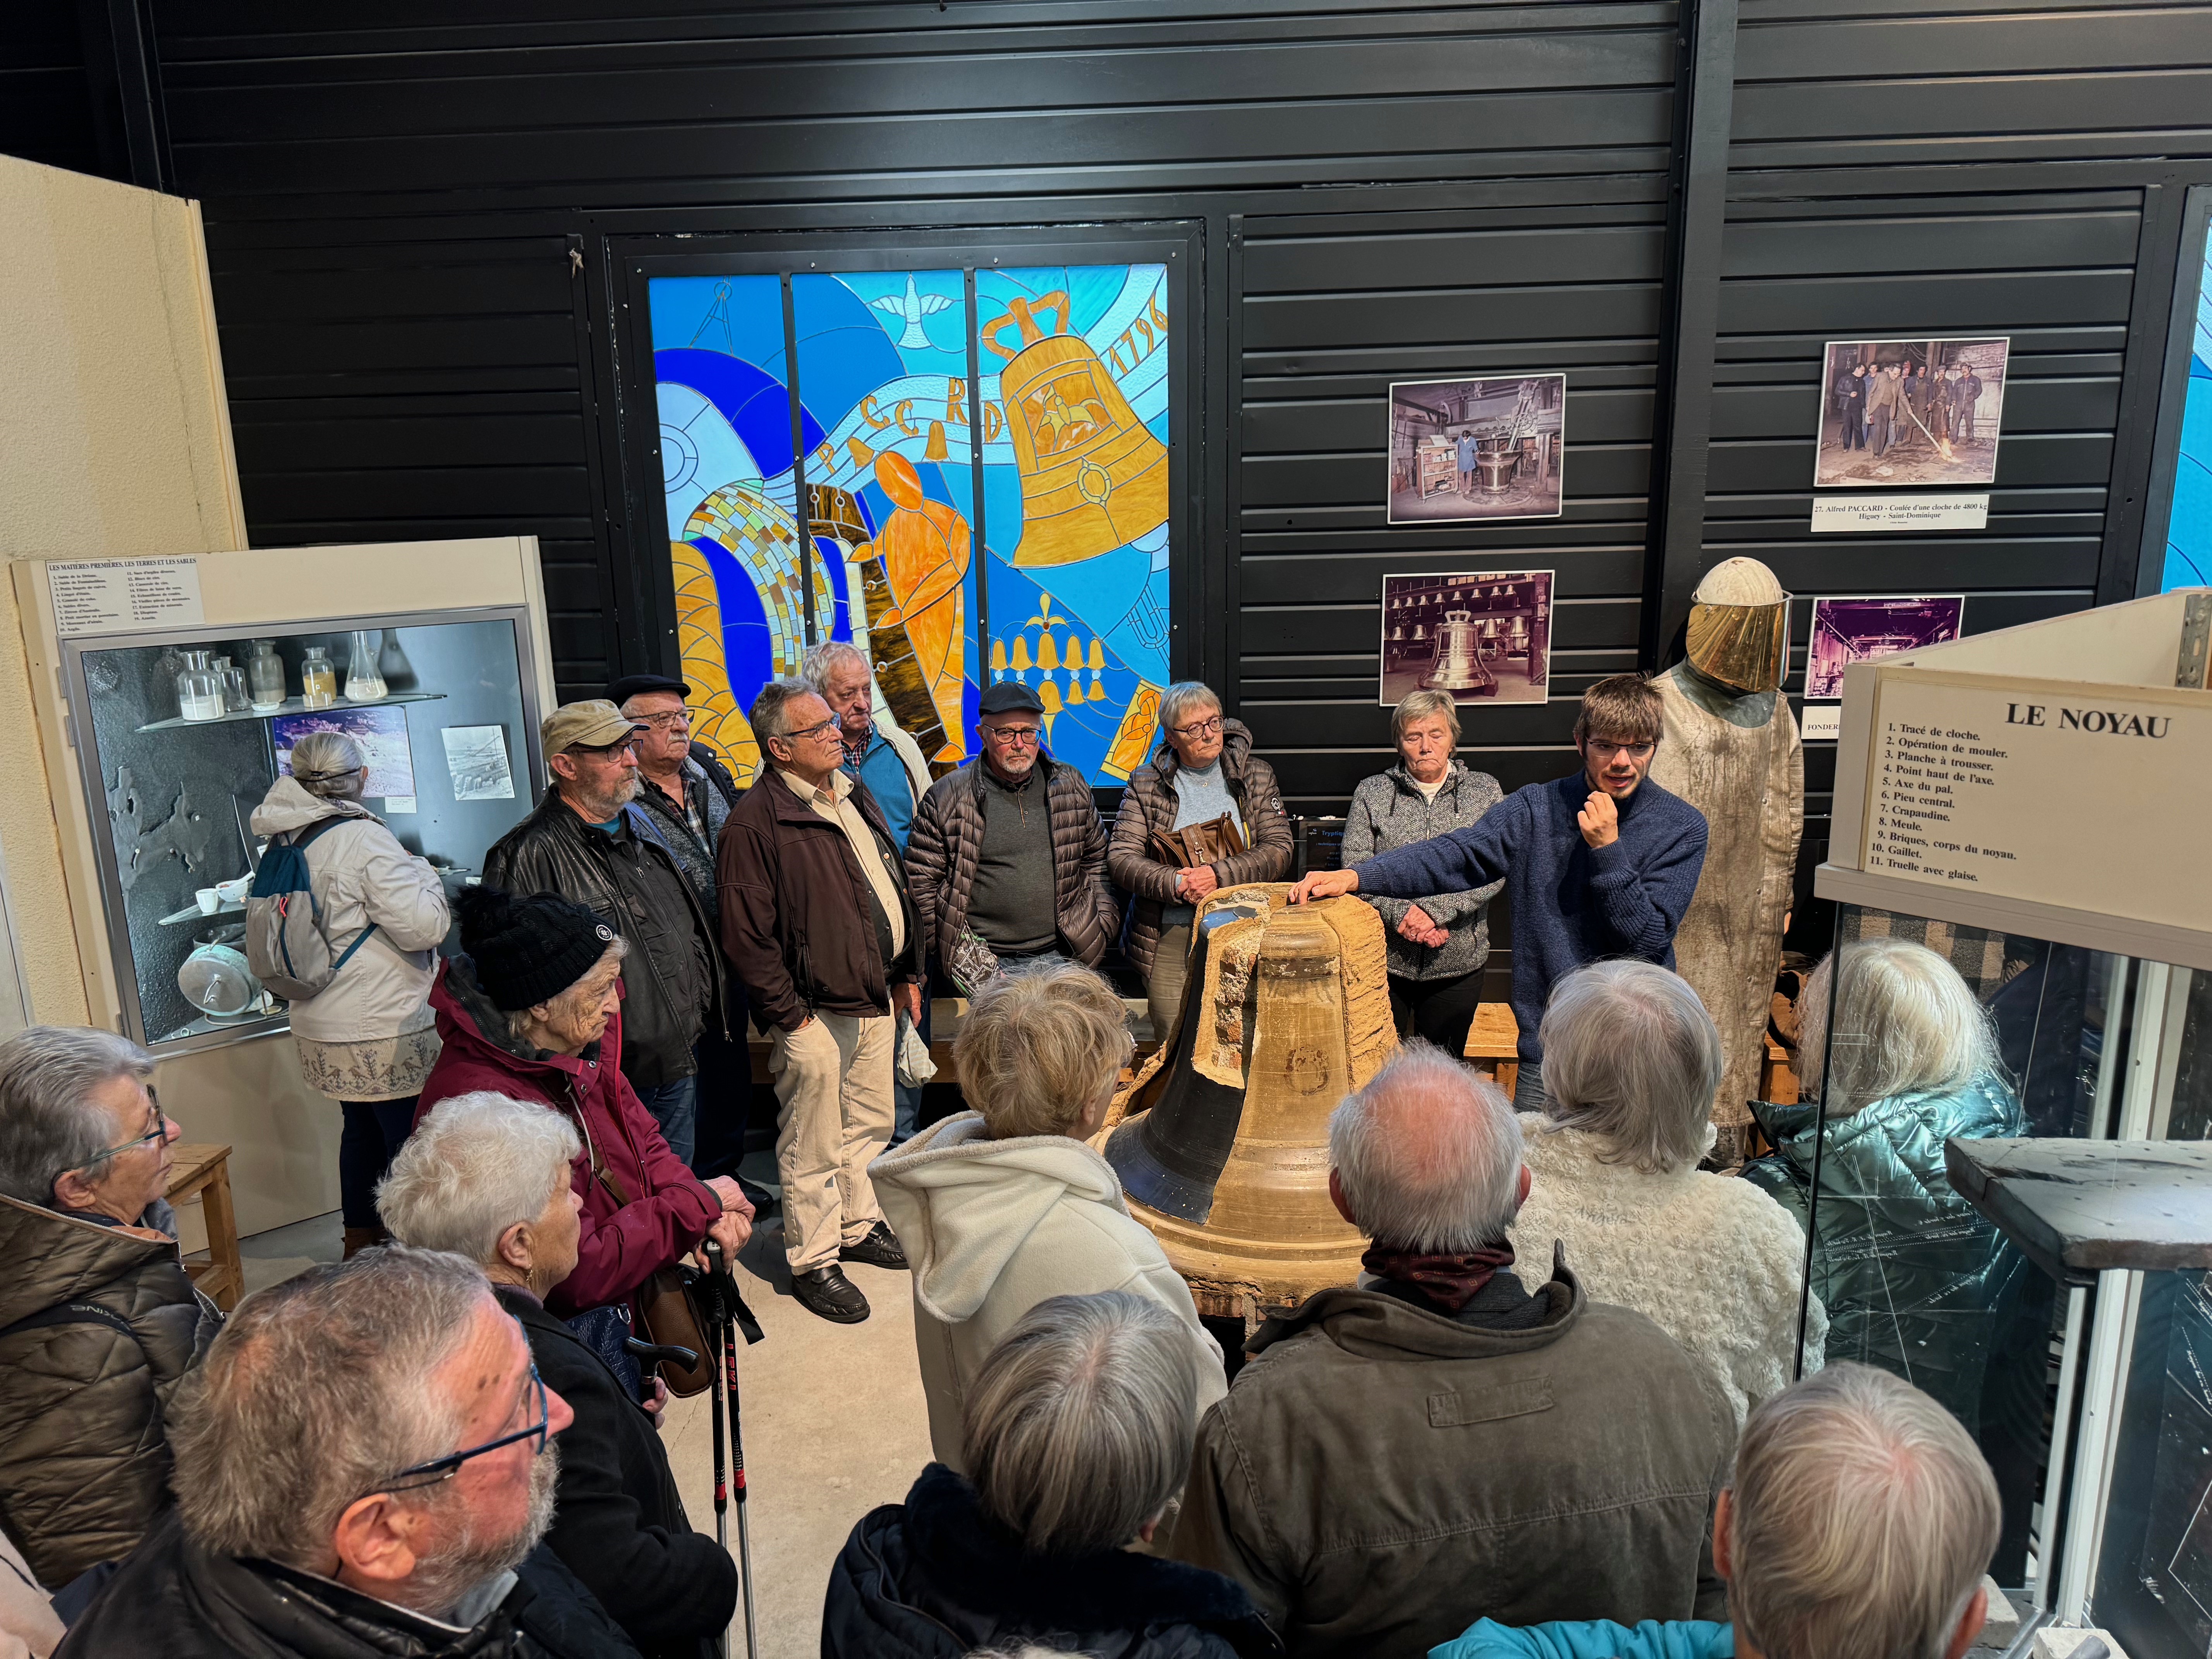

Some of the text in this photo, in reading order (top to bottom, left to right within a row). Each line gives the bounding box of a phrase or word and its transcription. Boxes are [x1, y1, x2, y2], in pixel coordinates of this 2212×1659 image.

[2005, 703, 2172, 738] LE NOYAU
[1888, 723, 1980, 741] 1. Tracé de cloche.
[1886, 736, 2008, 758] 2. Opération de mouler.
[1884, 749, 1994, 771] 3. Planche à trousser.
[1884, 763, 1994, 785] 4. Point haut de l'axe.
[1882, 777, 1953, 794] 5. Axe du pal.
[1881, 790, 1955, 809] 6. Pieu central.
[1880, 803, 1950, 822] 7. Crapaudine.
[1879, 817, 1922, 831] 8. Meule.
[1872, 843, 1922, 859] 10. Gaillet.
[1877, 830, 2016, 860] 9. Briques, corps du noyau.
[1870, 856, 1978, 882] 11. Truelle avec glaise.
